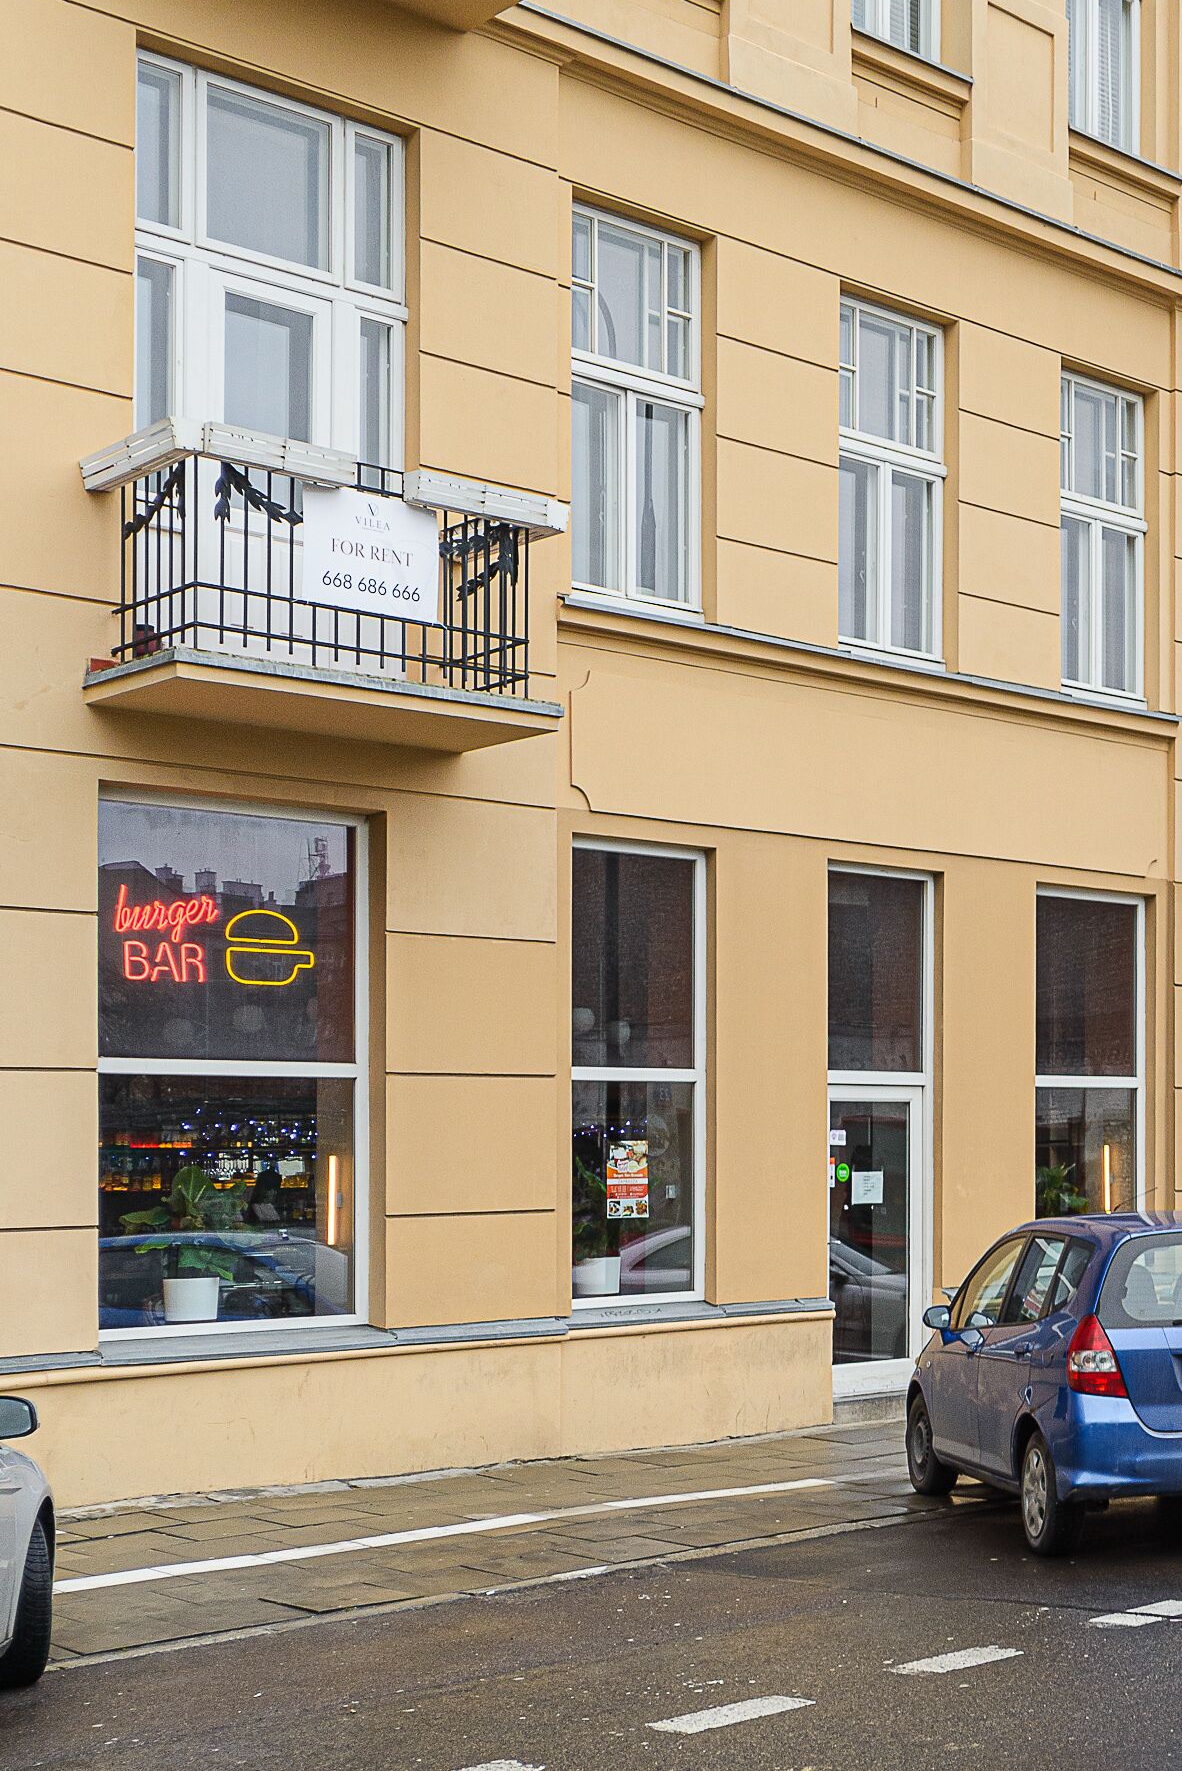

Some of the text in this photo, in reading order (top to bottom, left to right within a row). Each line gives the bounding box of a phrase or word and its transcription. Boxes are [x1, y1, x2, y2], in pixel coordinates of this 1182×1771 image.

[355, 516, 391, 531] VILEA
[331, 538, 413, 567] FOR RENT
[322, 570, 420, 602] 668 686 666
[114, 883, 219, 942] burger
[122, 940, 207, 983] BAR
